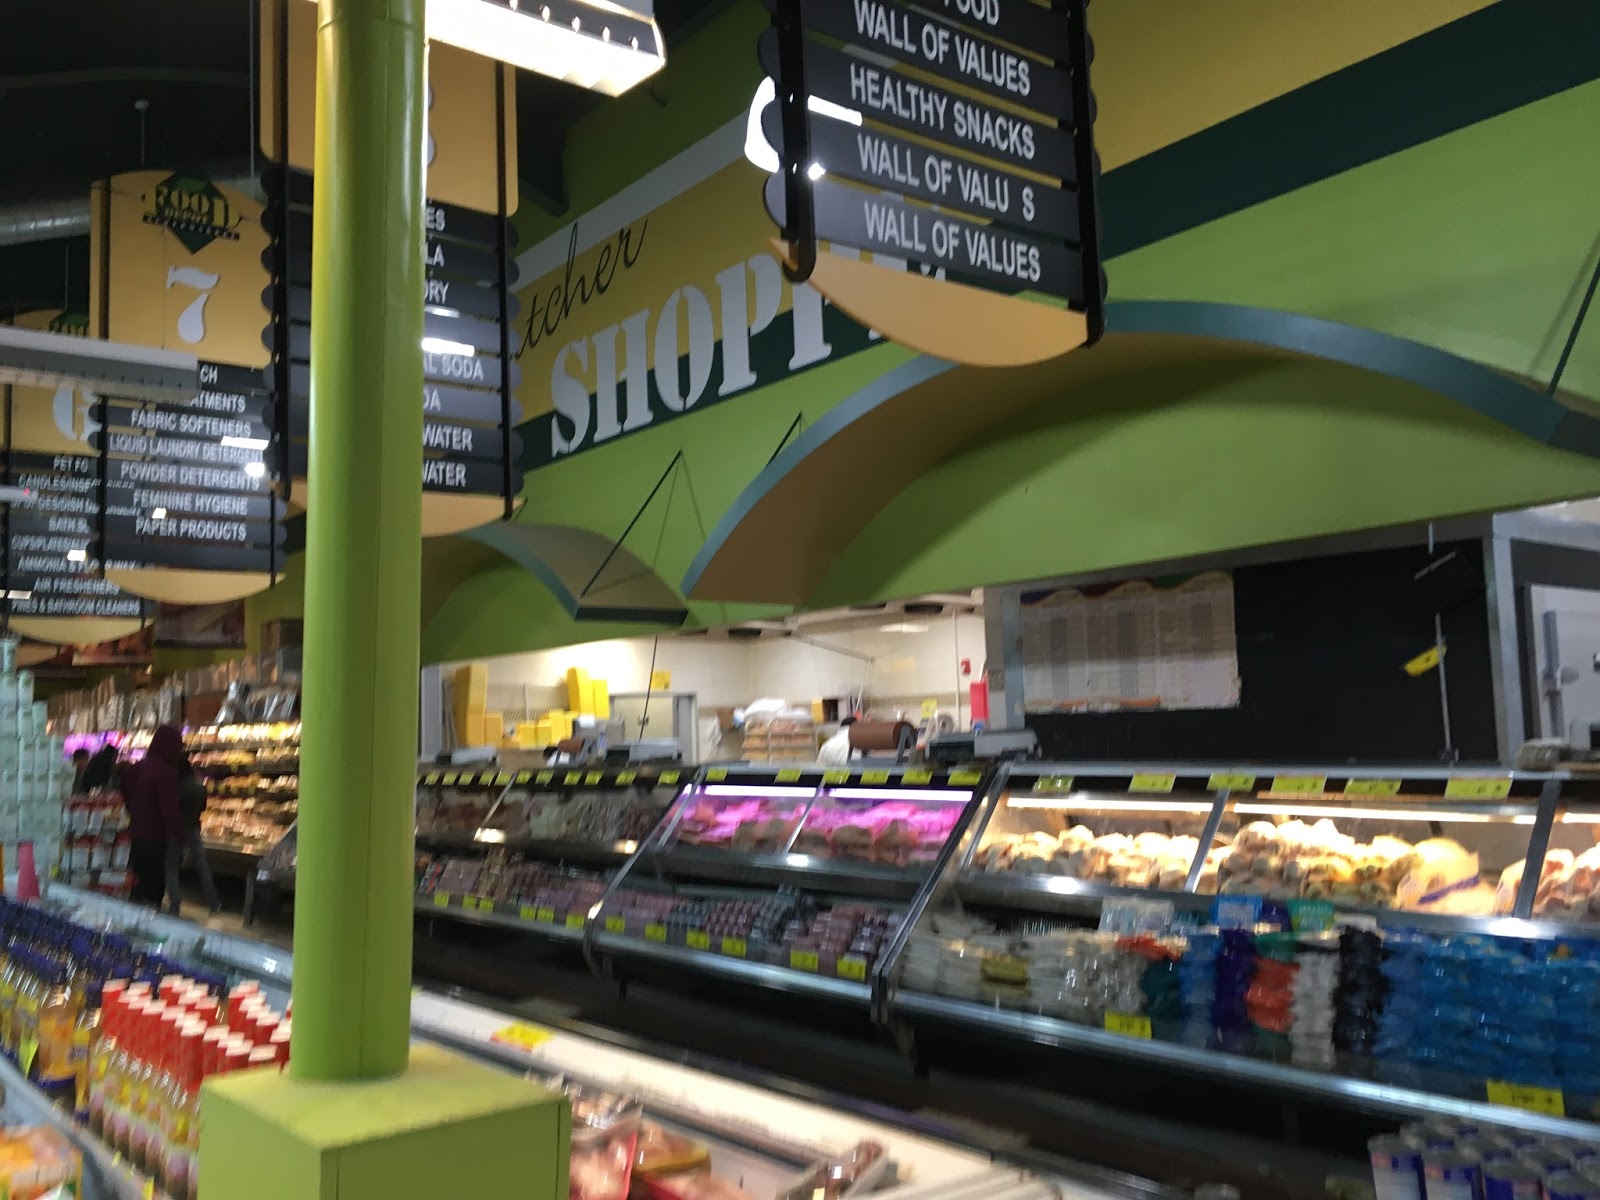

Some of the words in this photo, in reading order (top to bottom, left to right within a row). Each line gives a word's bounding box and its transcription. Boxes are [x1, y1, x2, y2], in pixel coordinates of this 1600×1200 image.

[944, 0, 999, 26] OD
[854, 0, 917, 54] WALL
[922, 23, 950, 64] OF
[955, 34, 1030, 96] VALUES
[850, 63, 947, 131] HEALTHY
[954, 105, 1035, 160] SNACKS
[857, 133, 920, 187] WALL
[924, 155, 953, 195] OF
[864, 202, 927, 256] WALL
[931, 220, 960, 260] OF
[965, 229, 1041, 283] VALUES
[166, 264, 221, 344] 7
[441, 353, 484, 381] SODA
[550, 253, 890, 458] SHOP
[131, 409, 177, 431] FABRIC
[180, 414, 252, 437] SOFTENERS
[109, 434, 147, 453] LIQUID
[150, 436, 200, 457] LAUNDRY
[121, 461, 177, 483] POWDER
[180, 467, 260, 490] DETERGENTS
[133, 488, 192, 511] FEMININE
[195, 493, 248, 515] HYGIENE
[135, 517, 177, 537] PAPER
[180, 518, 247, 541] PRODUCTS
